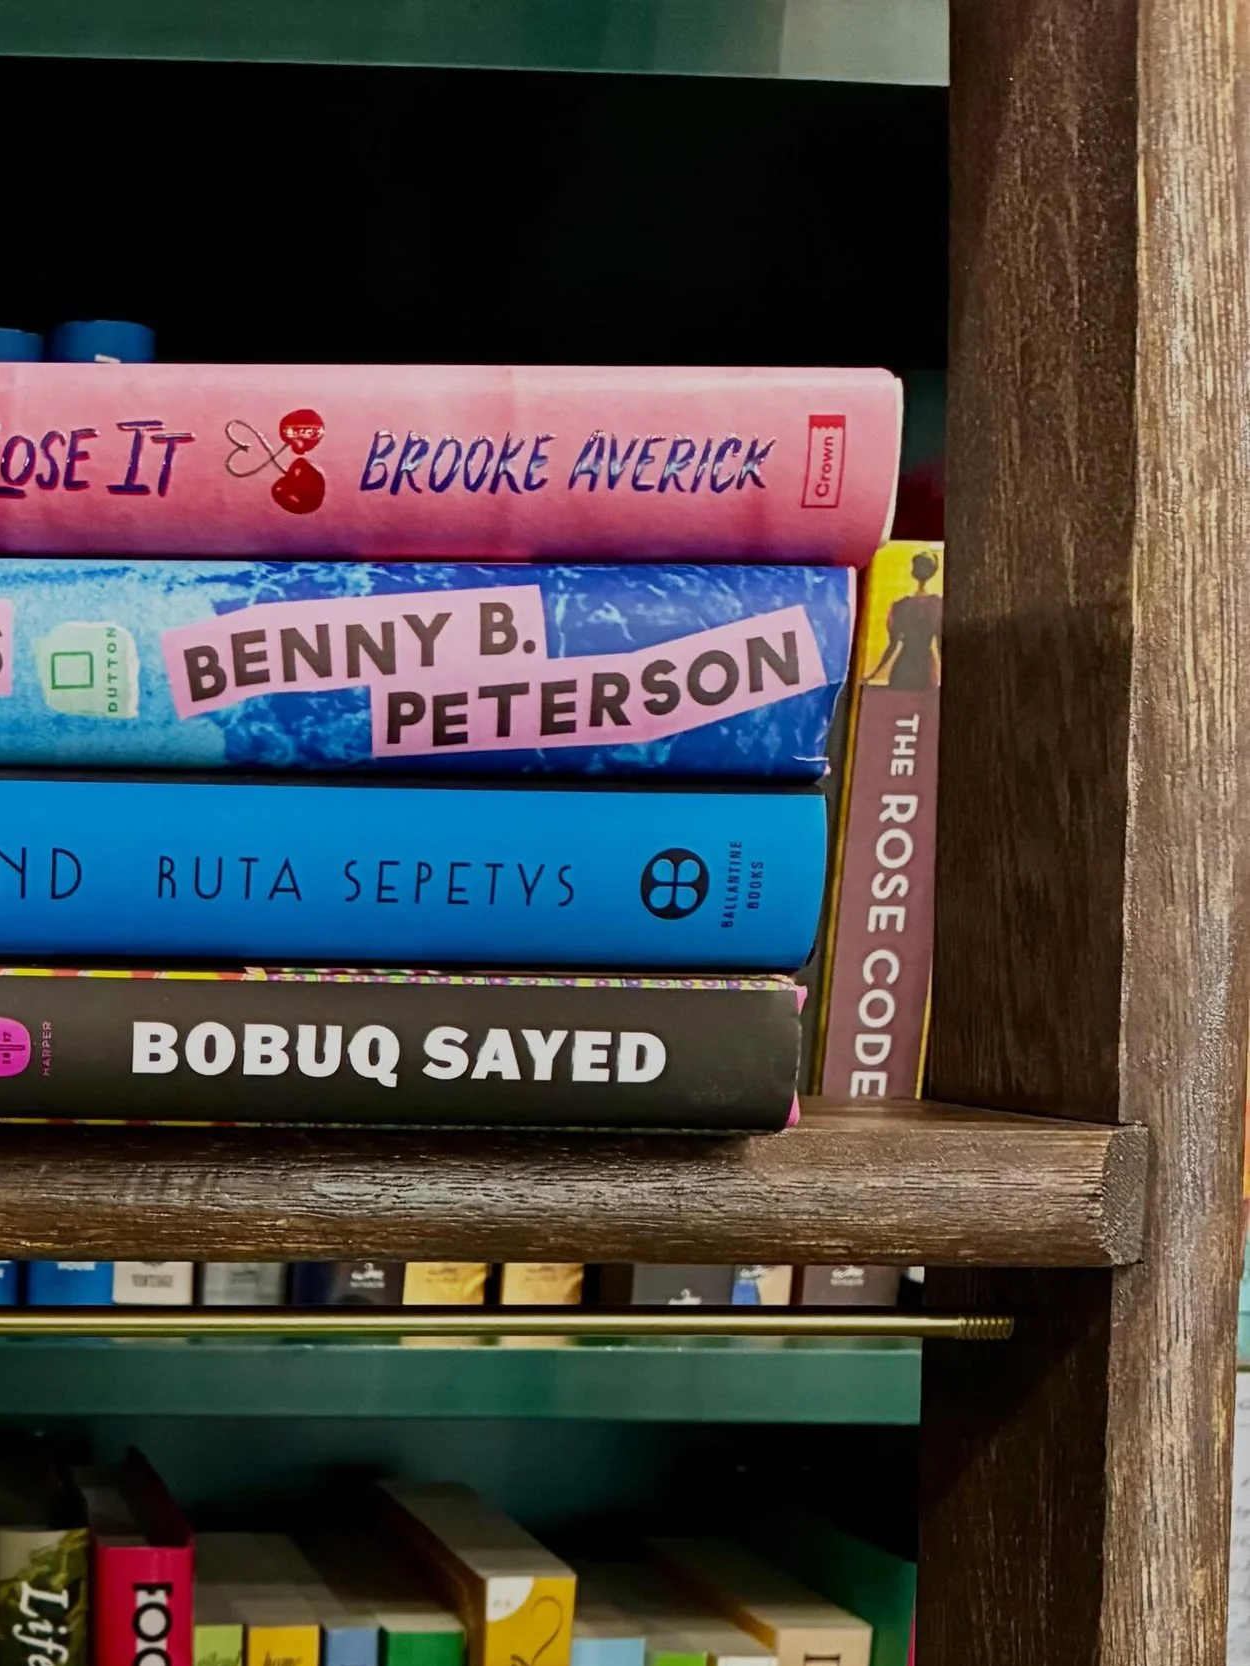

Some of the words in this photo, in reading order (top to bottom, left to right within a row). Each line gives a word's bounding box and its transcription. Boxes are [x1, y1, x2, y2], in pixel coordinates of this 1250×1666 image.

[105, 420, 196, 497] IT
[359, 429, 557, 496] BROOKE
[567, 429, 778, 495] AVERICK
[815, 434, 834, 498] Crown
[106, 626, 118, 714] DUTTON
[183, 612, 452, 703] BENNY
[479, 601, 537, 656] B.
[385, 629, 801, 747] PETERSON
[890, 713, 920, 777] THE
[157, 855, 303, 901] RUTA
[343, 859, 576, 908] SEPETYS
[719, 841, 743, 929] BALLANTINE
[745, 860, 765, 910] BOOKS
[866, 794, 919, 934] ROSE
[40, 1020, 53, 1077] HARPER
[131, 1020, 401, 1089] BOBUQ
[421, 1026, 667, 1084] SAYED
[850, 948, 901, 1099] CODE
